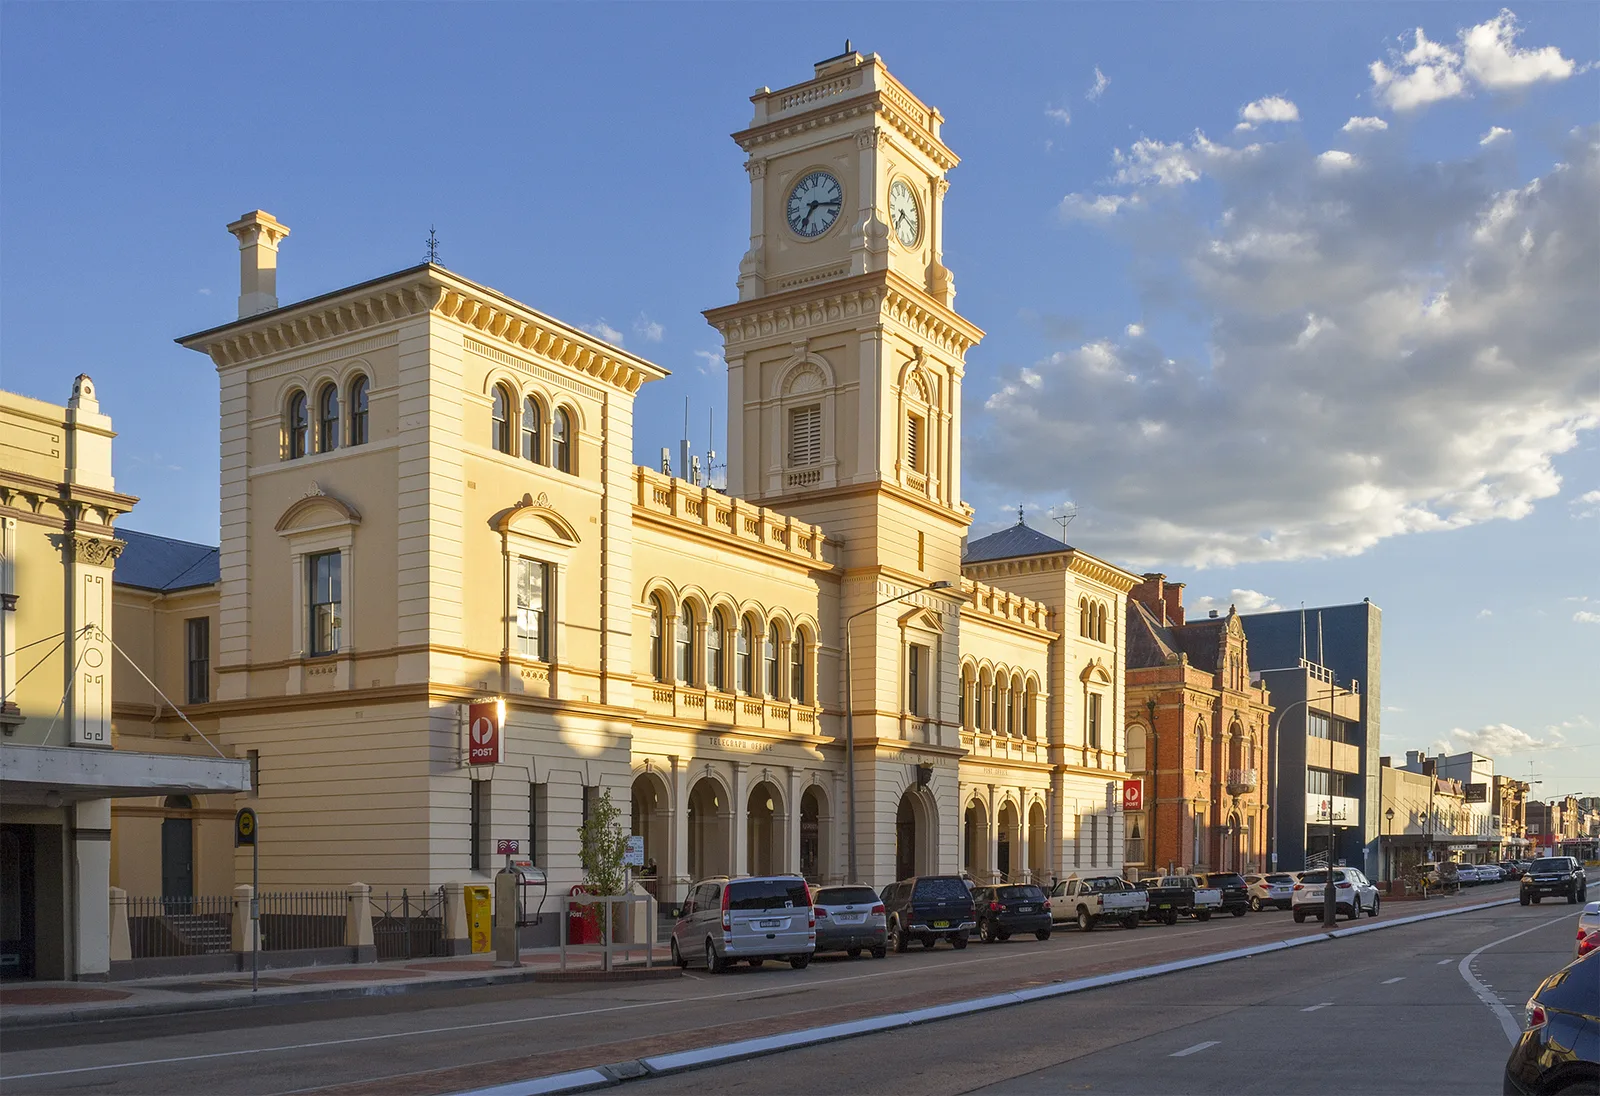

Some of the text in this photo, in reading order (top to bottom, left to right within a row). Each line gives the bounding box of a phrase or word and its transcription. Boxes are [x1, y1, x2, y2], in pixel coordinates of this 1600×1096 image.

[709, 737, 774, 751] TELEGRAPH OFFICE
[472, 747, 493, 757] POST
